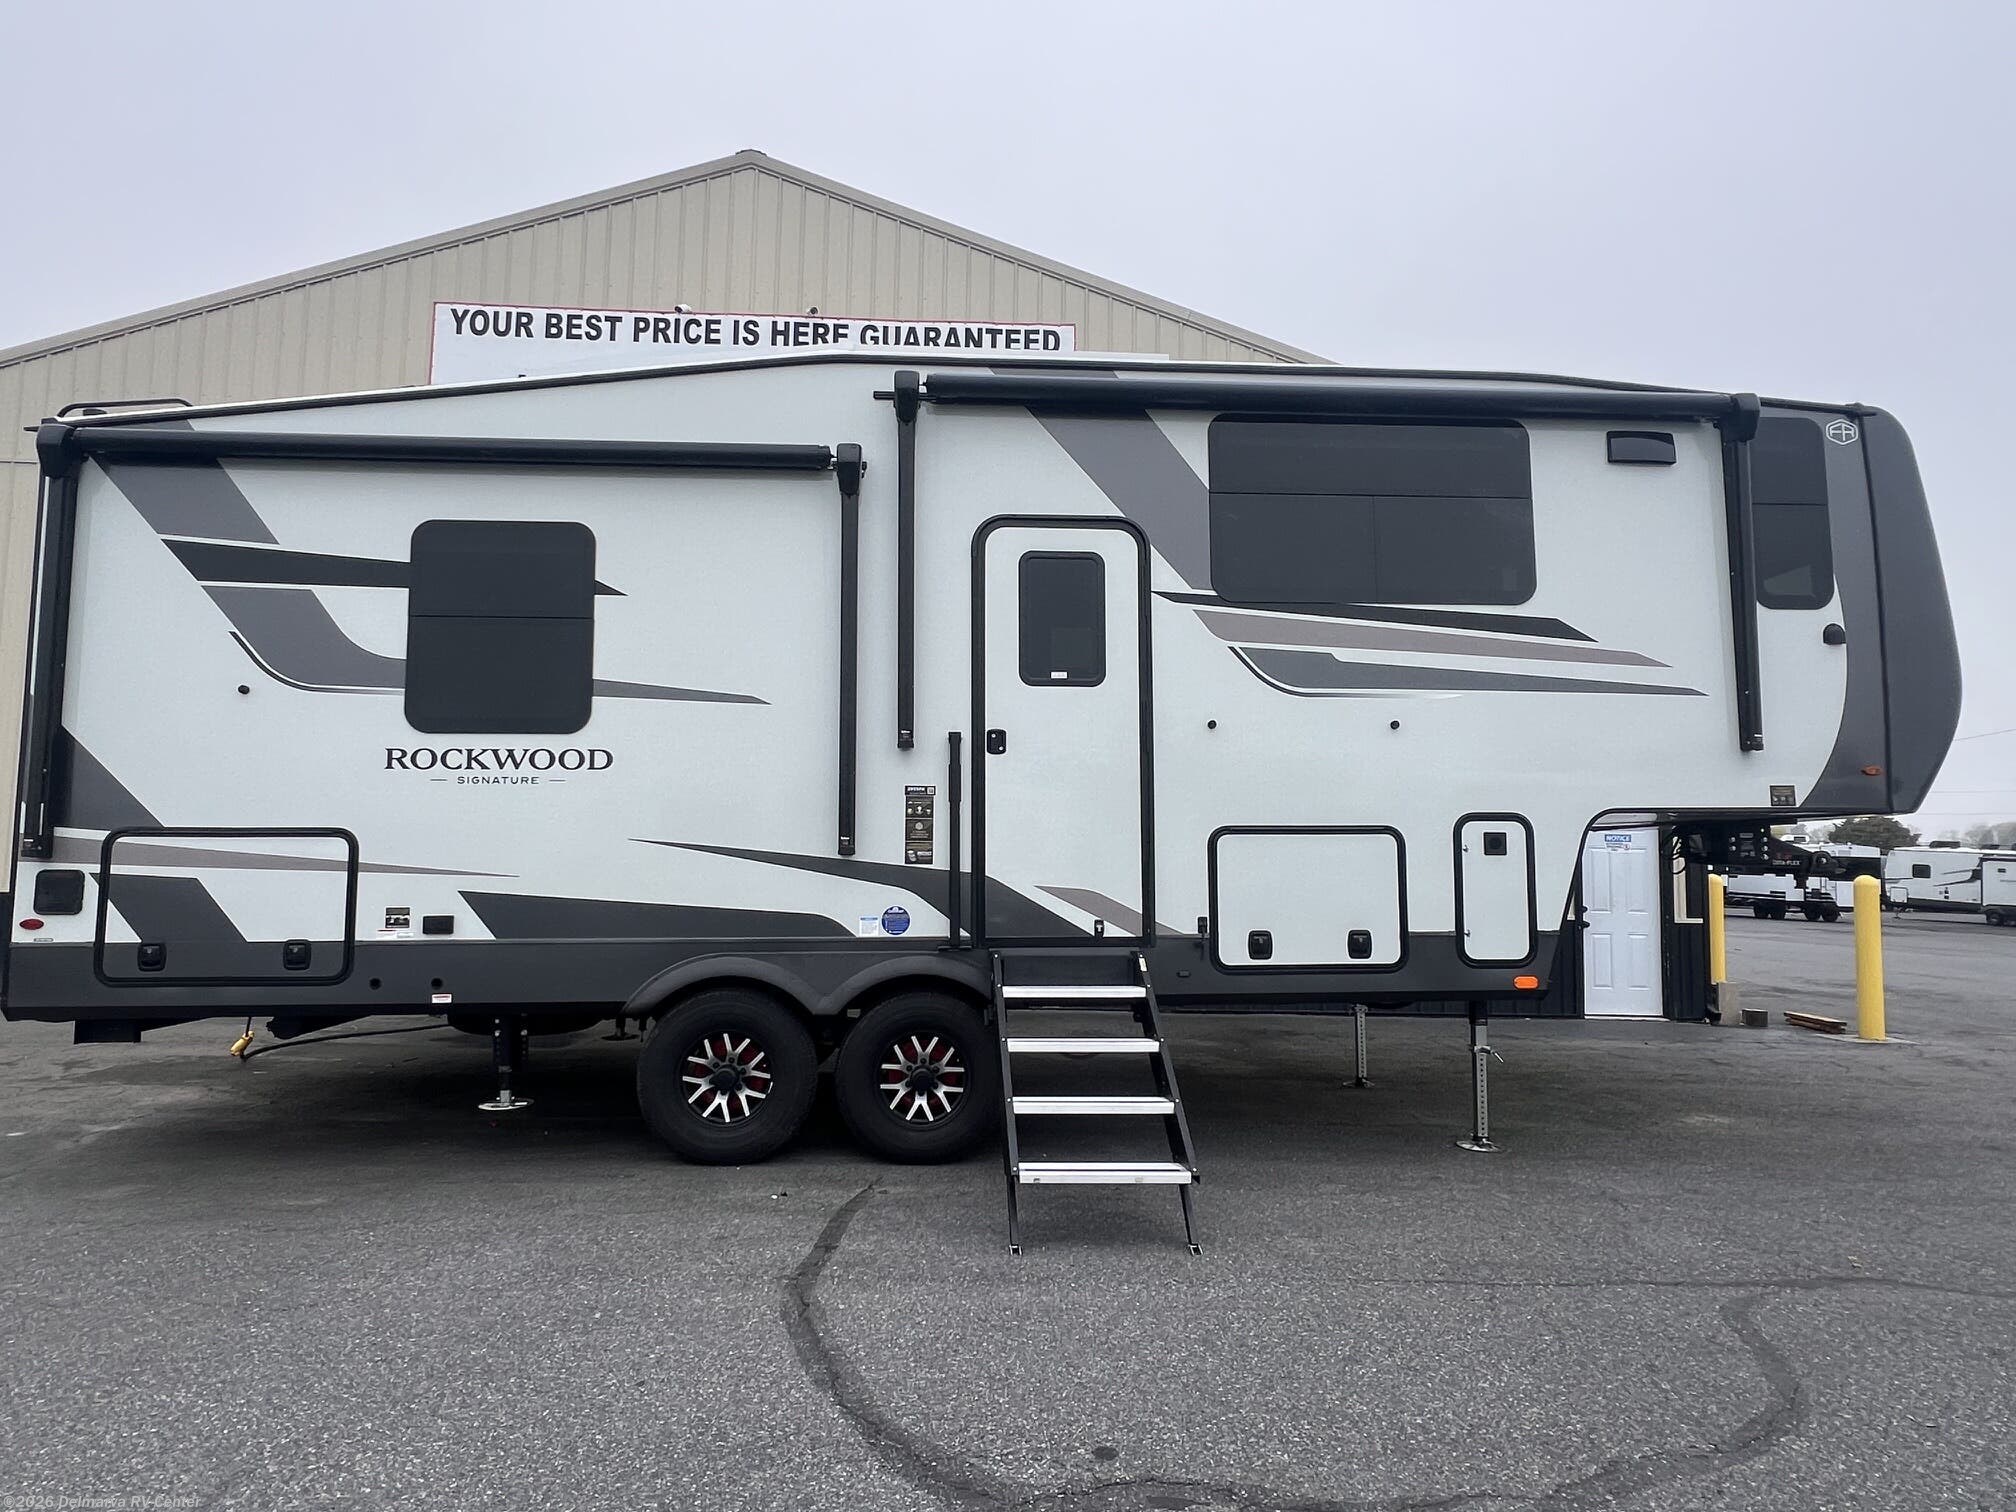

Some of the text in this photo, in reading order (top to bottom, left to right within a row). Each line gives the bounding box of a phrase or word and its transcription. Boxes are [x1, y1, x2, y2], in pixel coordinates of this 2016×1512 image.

[450, 308, 534, 338] YOUR
[545, 313, 622, 342] BEST
[633, 315, 722, 345] PRICE
[732, 319, 760, 346] IS
[384, 747, 614, 771] ROCKWOOD
[457, 776, 540, 785] SIGNATURE
